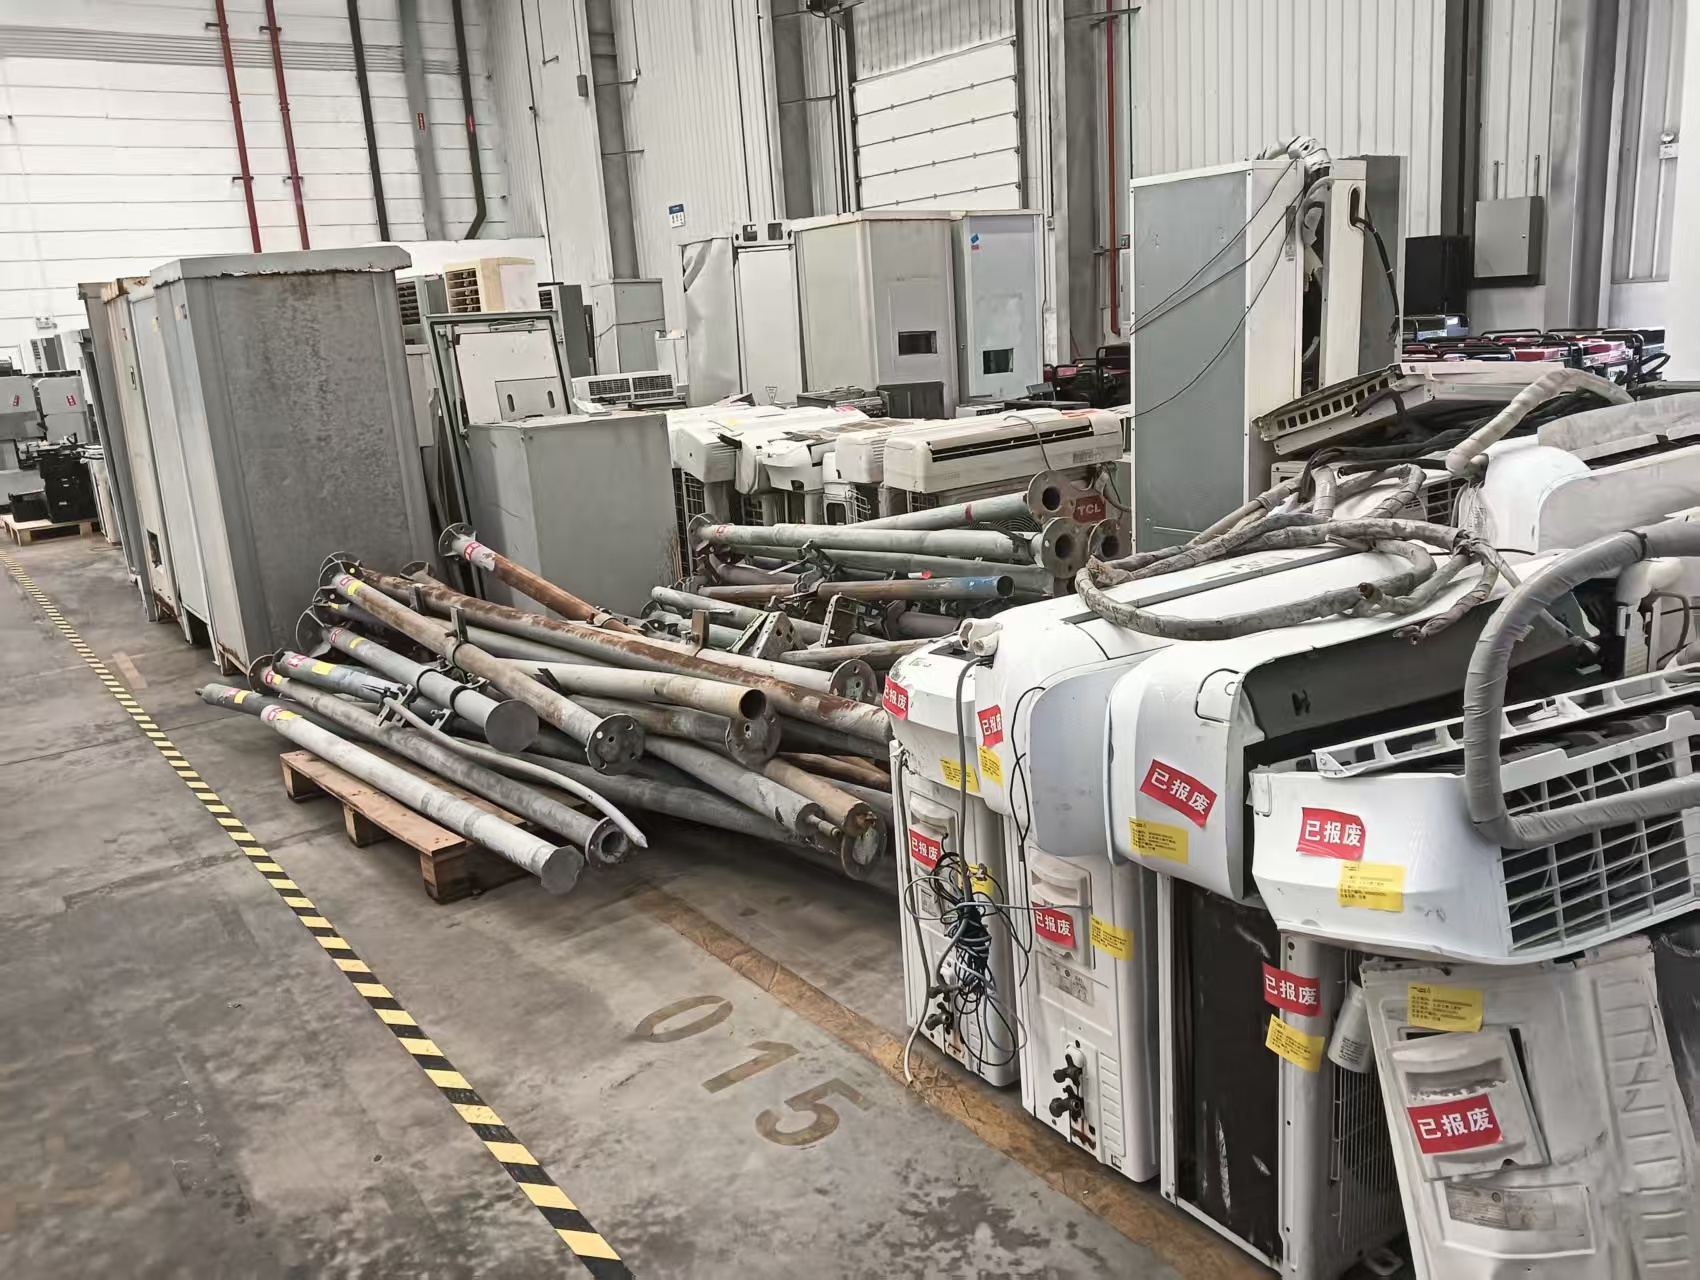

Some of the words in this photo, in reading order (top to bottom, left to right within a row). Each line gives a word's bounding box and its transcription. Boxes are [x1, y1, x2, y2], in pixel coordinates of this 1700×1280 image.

[1077, 503, 1101, 516] TCL
[885, 684, 907, 711] 已报废
[1151, 768, 1210, 815] 已报废
[1305, 819, 1362, 847] 已报废
[911, 837, 938, 861] 已报废
[1034, 910, 1071, 937] 已报废
[1265, 973, 1317, 1005] 已报废
[633, 995, 873, 1146] 015
[1416, 1107, 1494, 1140] 已报废
